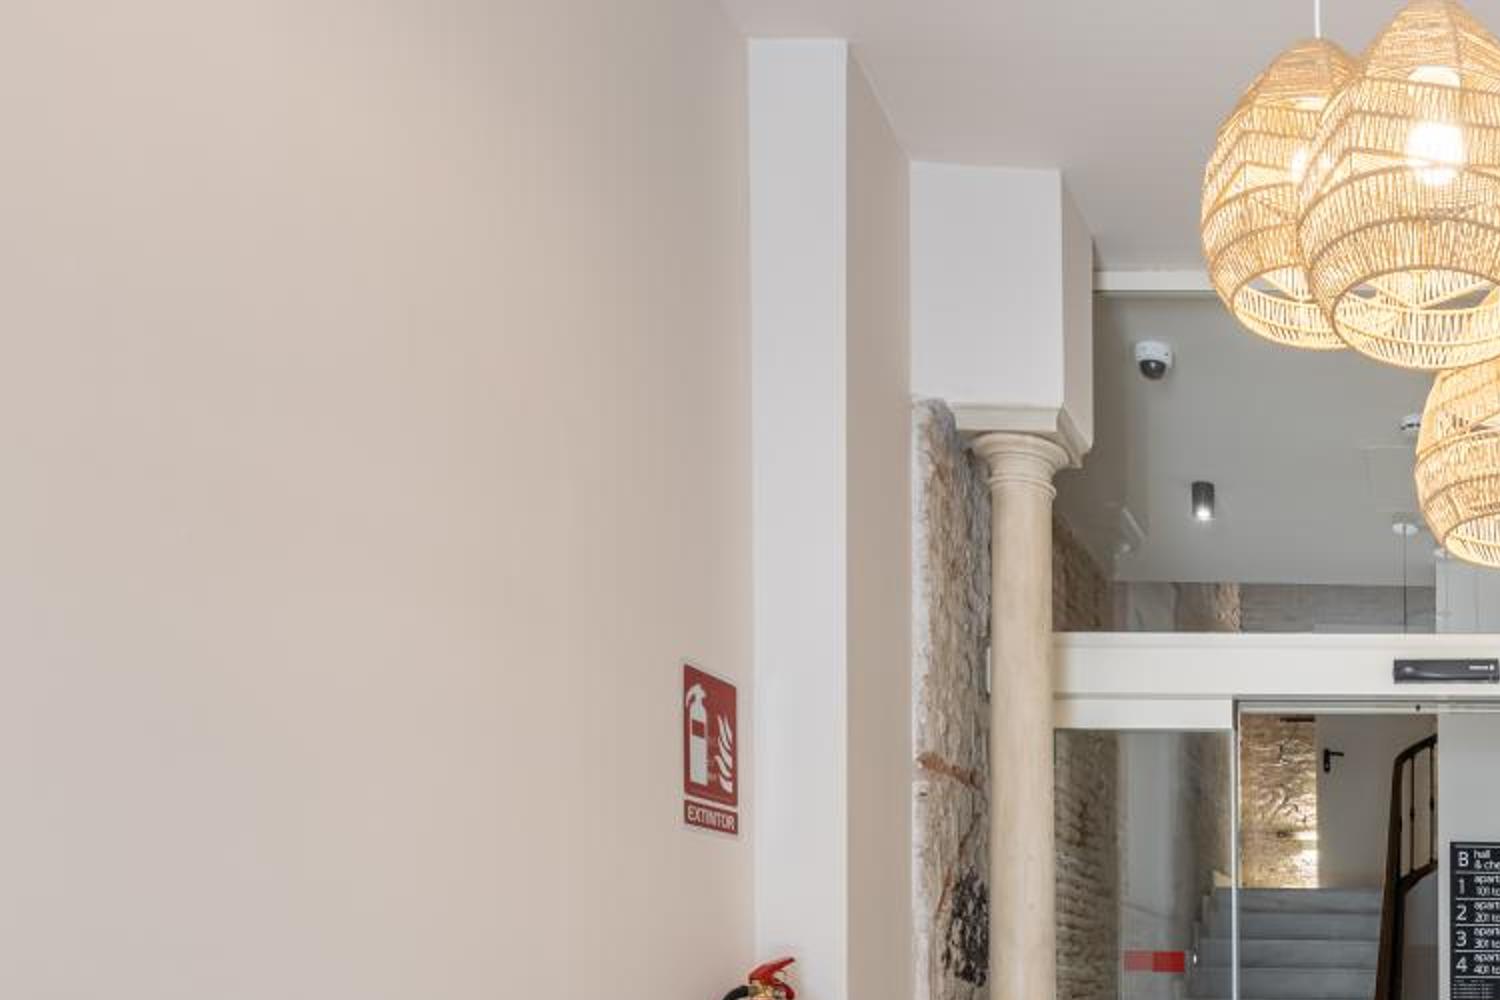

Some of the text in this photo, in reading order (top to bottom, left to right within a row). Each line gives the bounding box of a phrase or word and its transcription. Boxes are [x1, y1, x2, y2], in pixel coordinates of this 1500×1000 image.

[687, 804, 735, 831] EXTINTOR
[1458, 851, 1469, 867] B
[1473, 850, 1491, 859] hall
[1459, 878, 1465, 895] 1
[1475, 886, 1490, 896] 101
[1456, 904, 1467, 921] 2
[1475, 912, 1490, 922] 201
[1456, 930, 1467, 947] 3
[1474, 938, 1489, 949] 301
[1456, 956, 1468, 973] 4
[1473, 964, 1490, 975] 401
